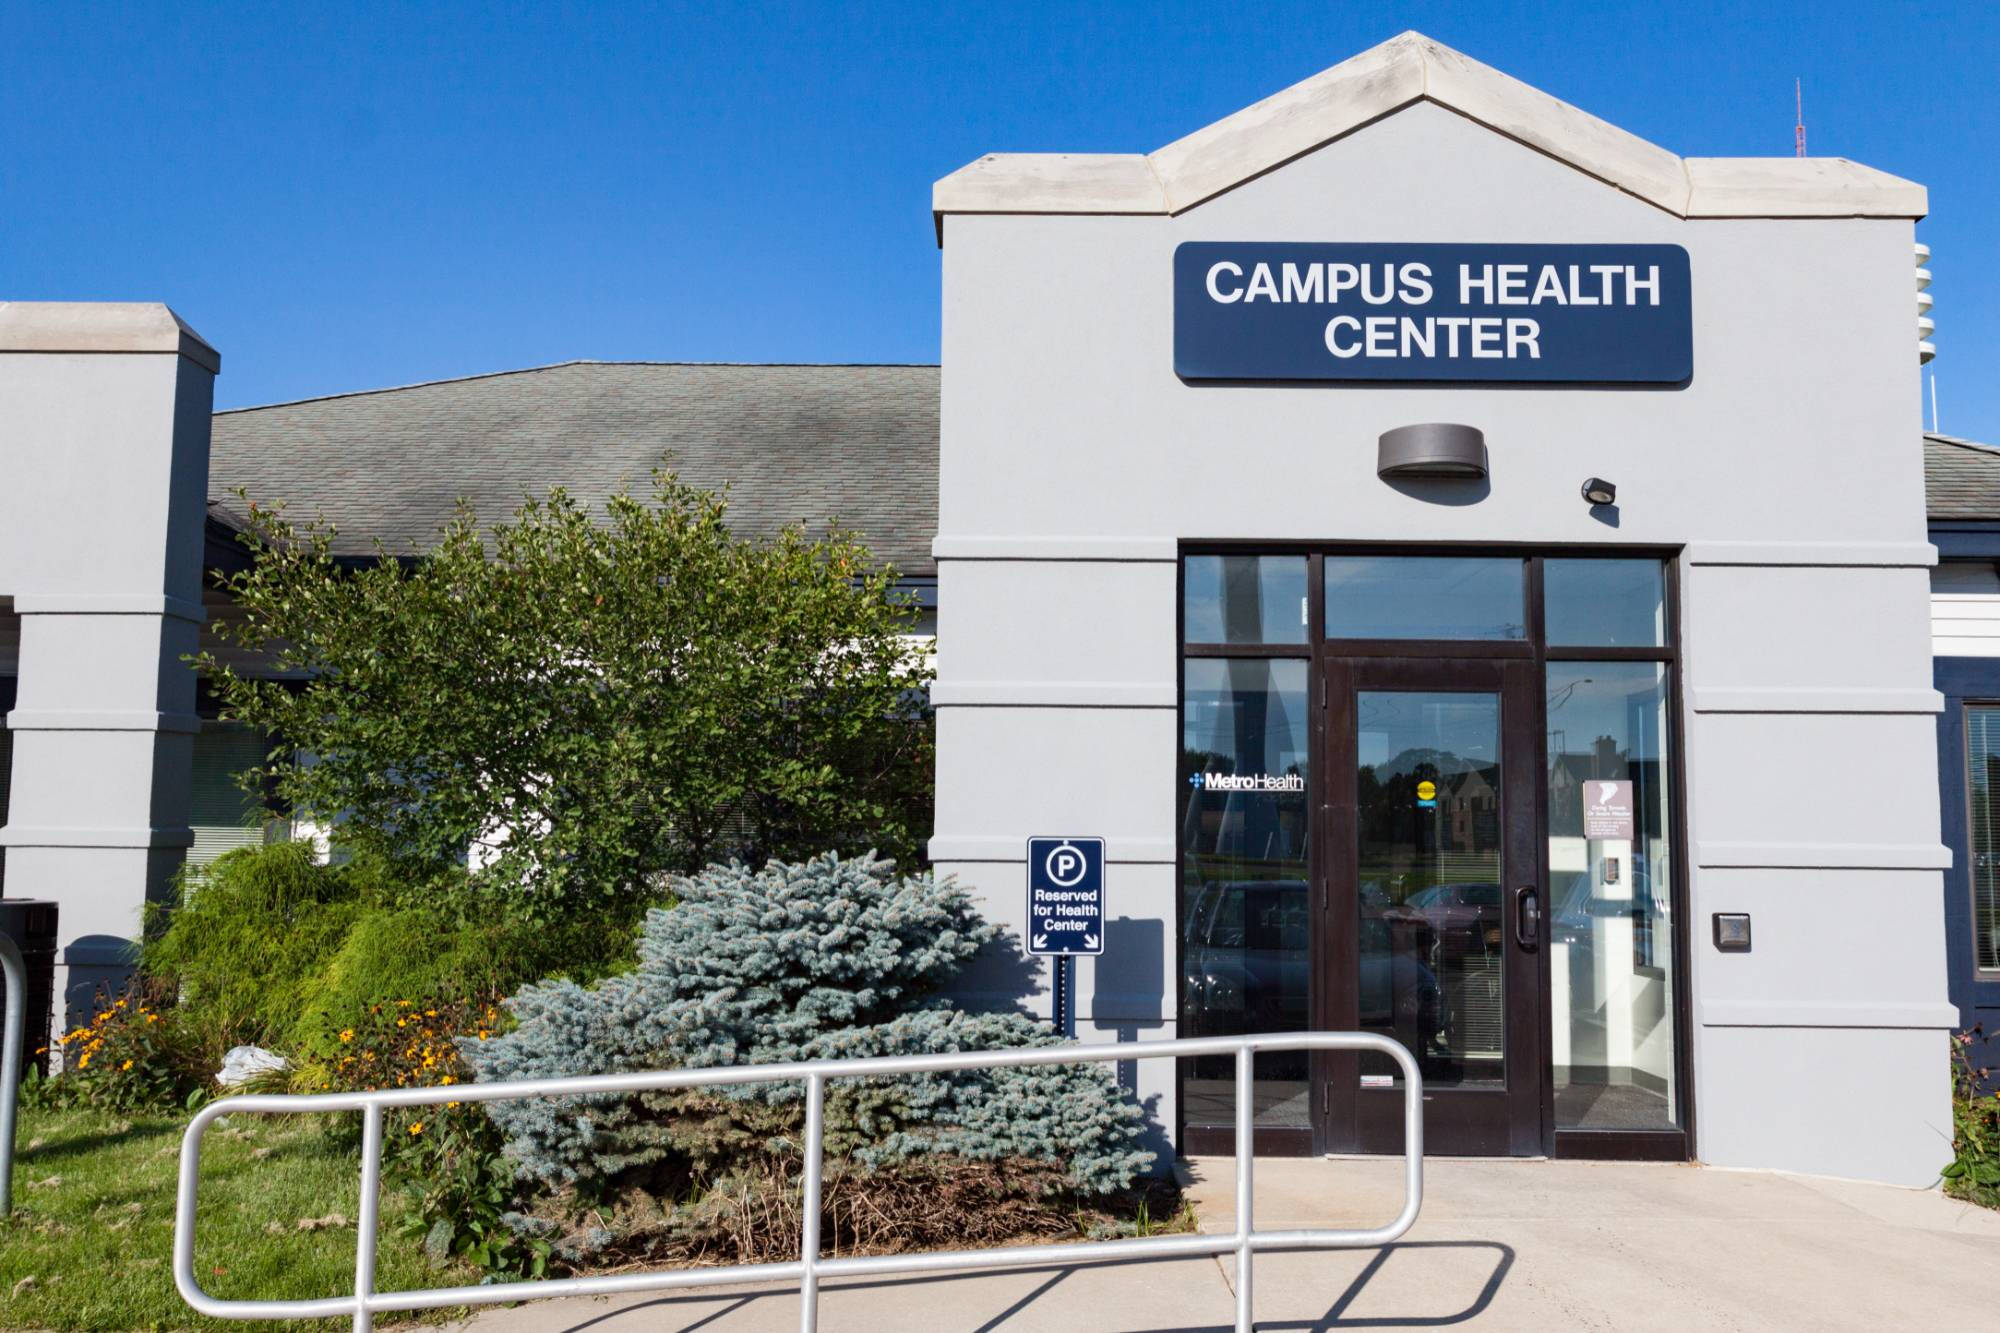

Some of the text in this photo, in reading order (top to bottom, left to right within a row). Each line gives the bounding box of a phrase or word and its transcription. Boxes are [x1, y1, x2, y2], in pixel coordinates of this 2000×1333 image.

[1205, 261, 1660, 306] CAMPUS HEALTH
[1324, 315, 1541, 359] CENTER
[1204, 773, 1304, 790] MetroHealth
[1058, 855, 1075, 877] P
[1035, 889, 1098, 902] Reserved
[1034, 904, 1099, 917] for Health
[1044, 919, 1089, 932] Center
